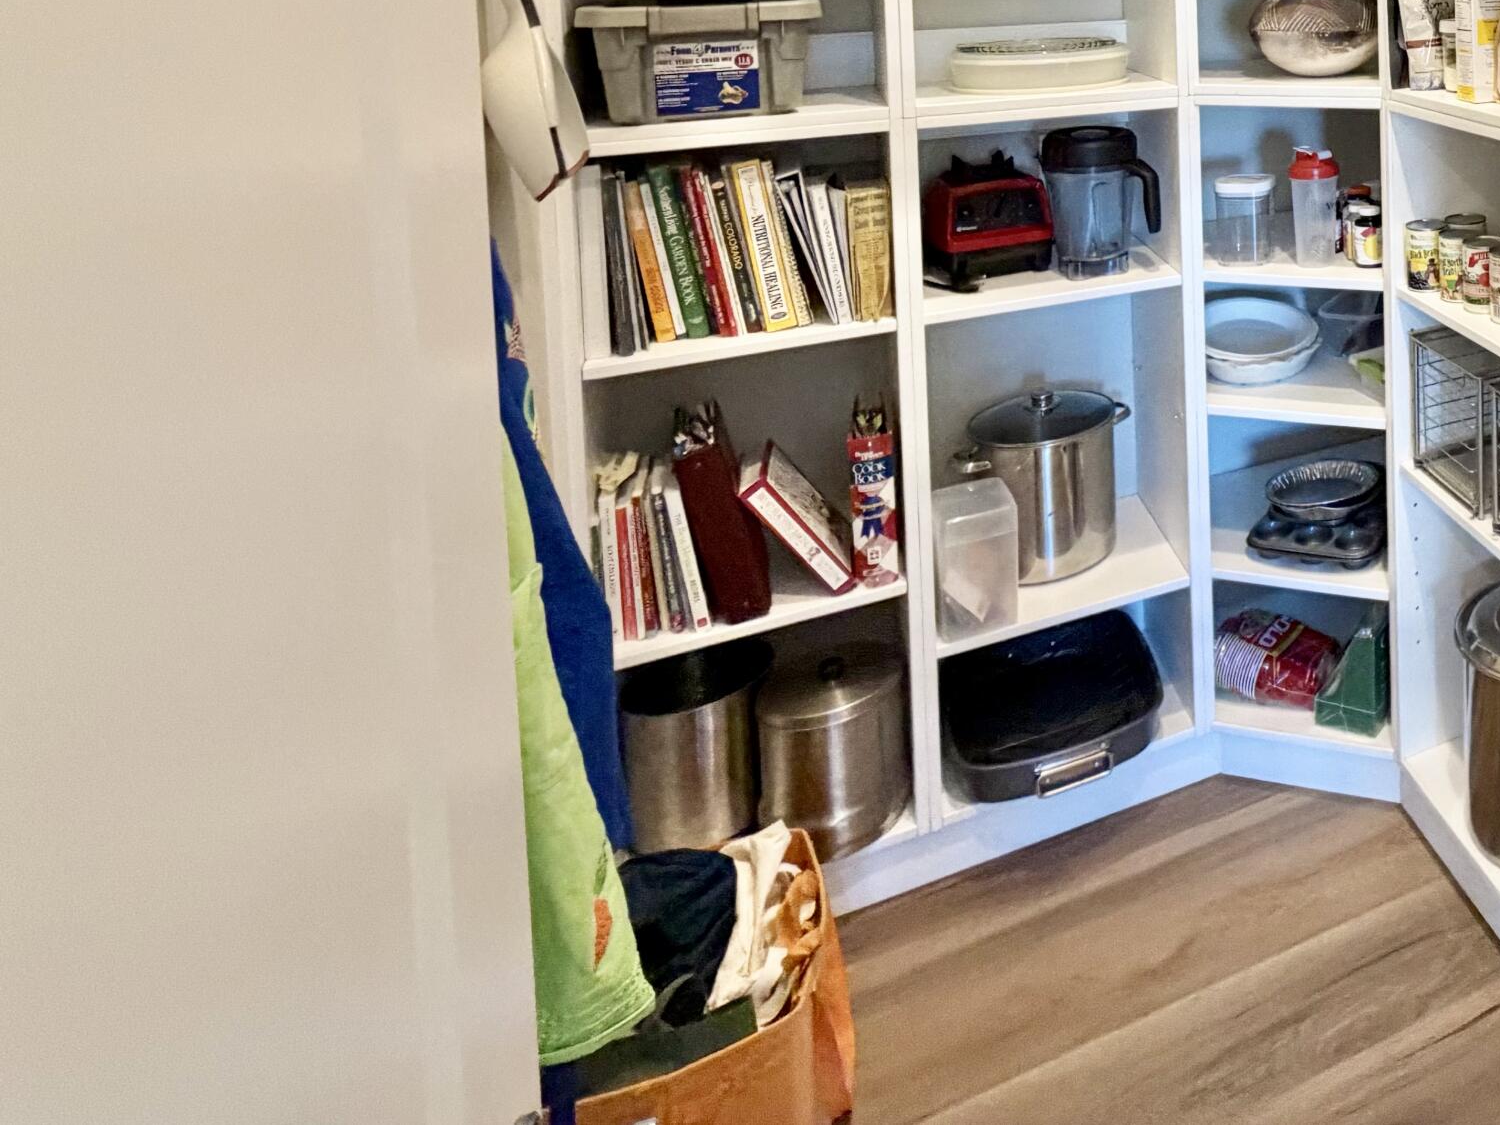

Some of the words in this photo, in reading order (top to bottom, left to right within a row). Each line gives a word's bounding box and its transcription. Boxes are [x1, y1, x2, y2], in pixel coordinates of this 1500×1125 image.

[724, 222, 744, 271] COLORADO
[751, 213, 775, 271] NUTRITIONAL
[763, 269, 784, 311] HEALING
